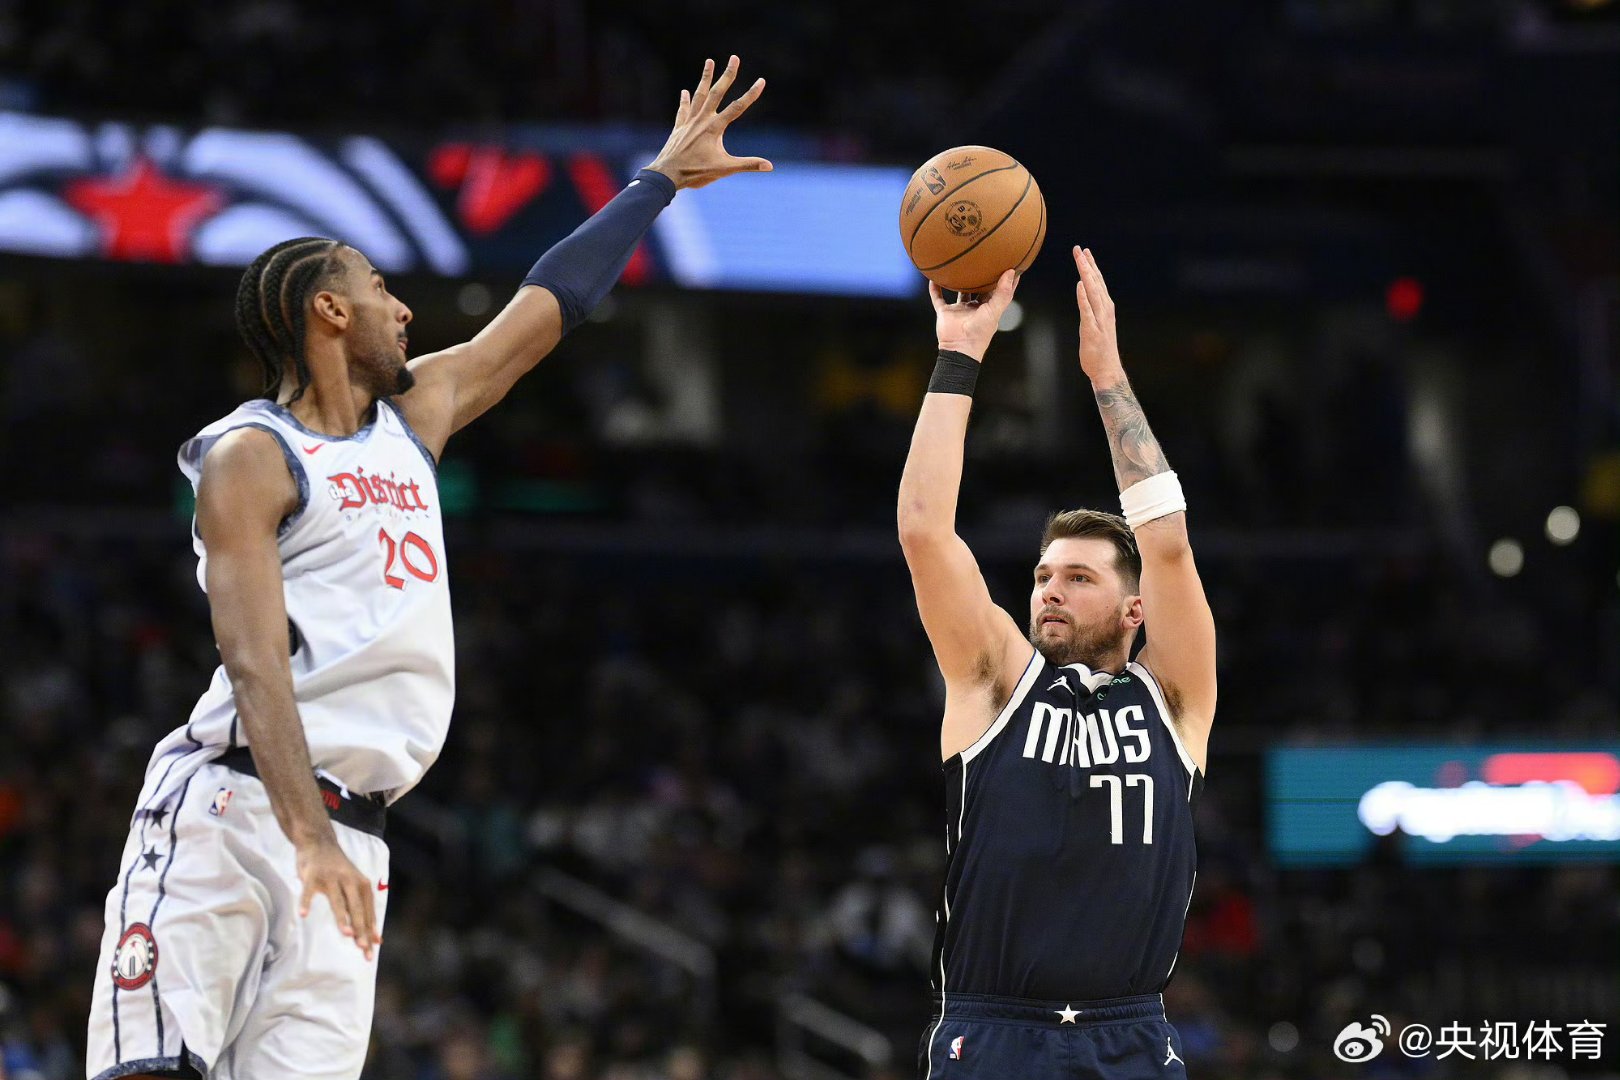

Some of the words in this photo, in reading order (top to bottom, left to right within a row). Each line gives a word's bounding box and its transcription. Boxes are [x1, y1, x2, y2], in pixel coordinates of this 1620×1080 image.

[378, 527, 440, 590] 20
[1022, 702, 1151, 768] MAVS
[1089, 774, 1154, 845] 77
